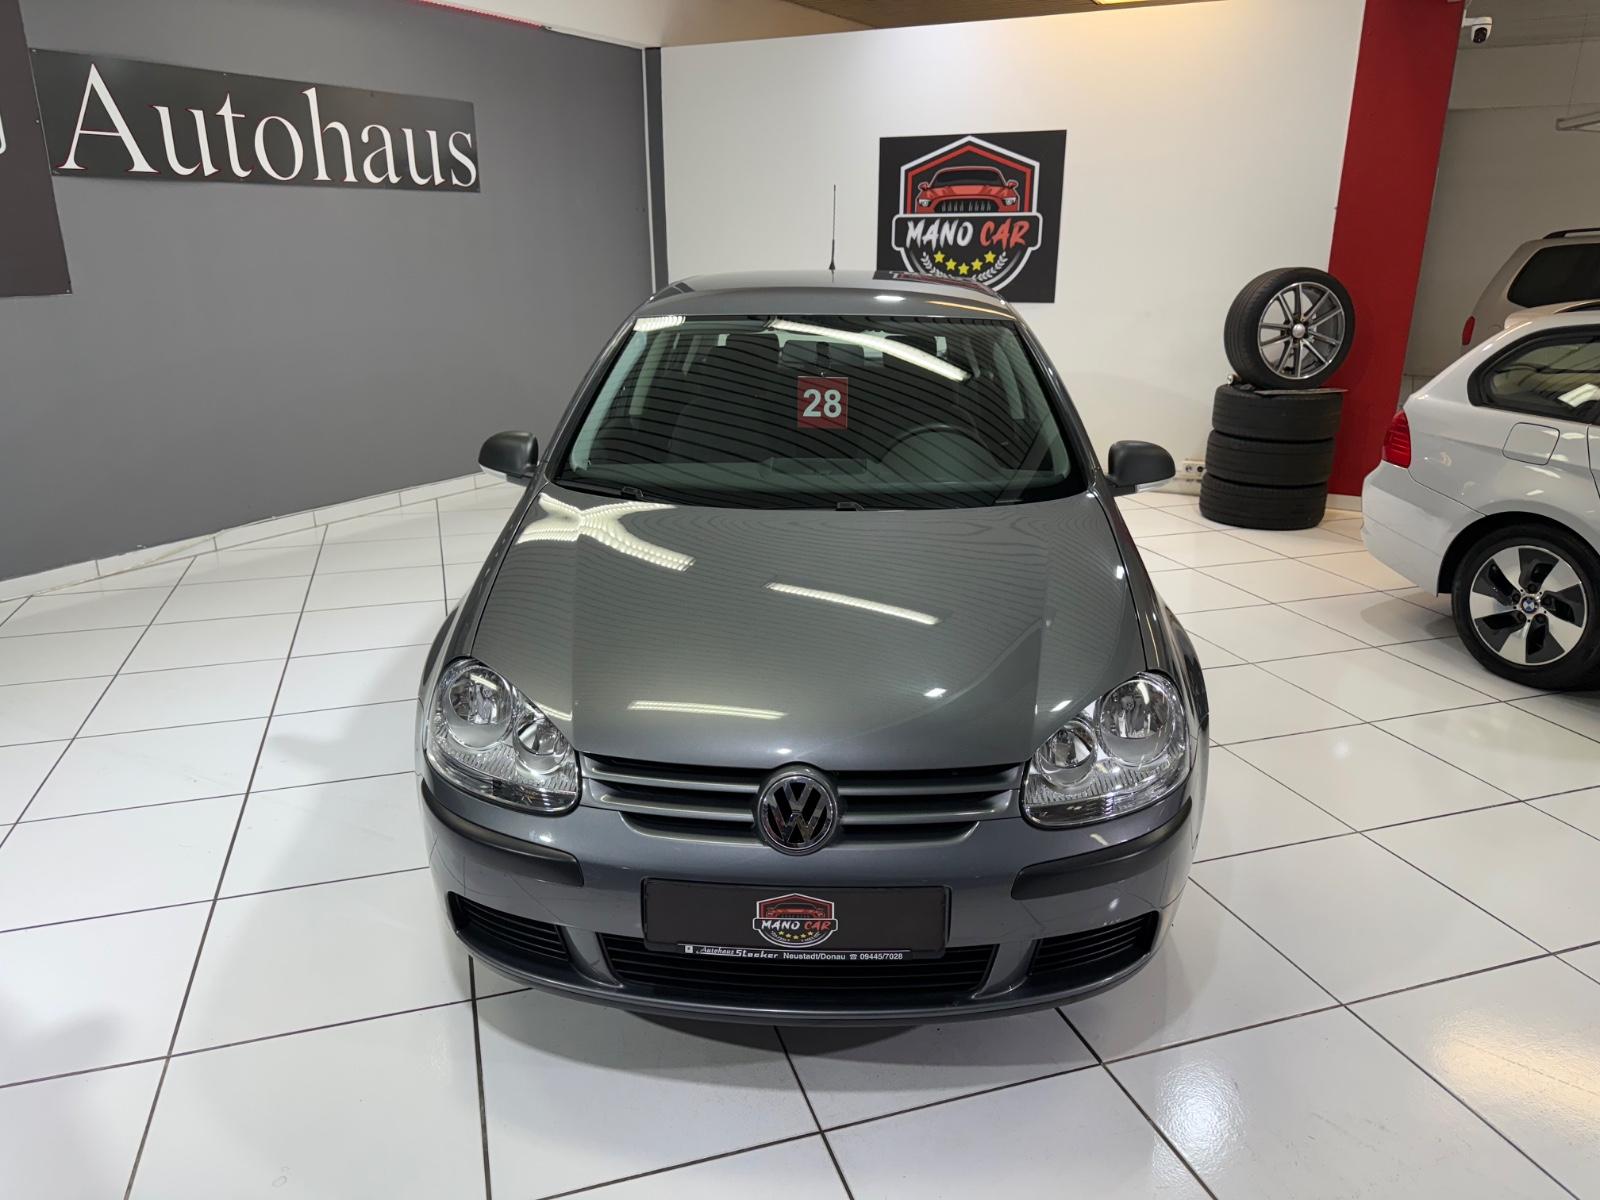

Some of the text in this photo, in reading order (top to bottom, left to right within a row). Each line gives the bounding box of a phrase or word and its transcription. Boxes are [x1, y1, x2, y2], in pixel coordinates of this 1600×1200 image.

[57, 63, 478, 188] Autohaus
[905, 218, 1030, 251] MANO CAR
[803, 388, 842, 418] 28
[761, 919, 832, 931] MANO CAR
[700, 946, 735, 955] Autohaus
[783, 952, 846, 960] Neustadt/Donau
